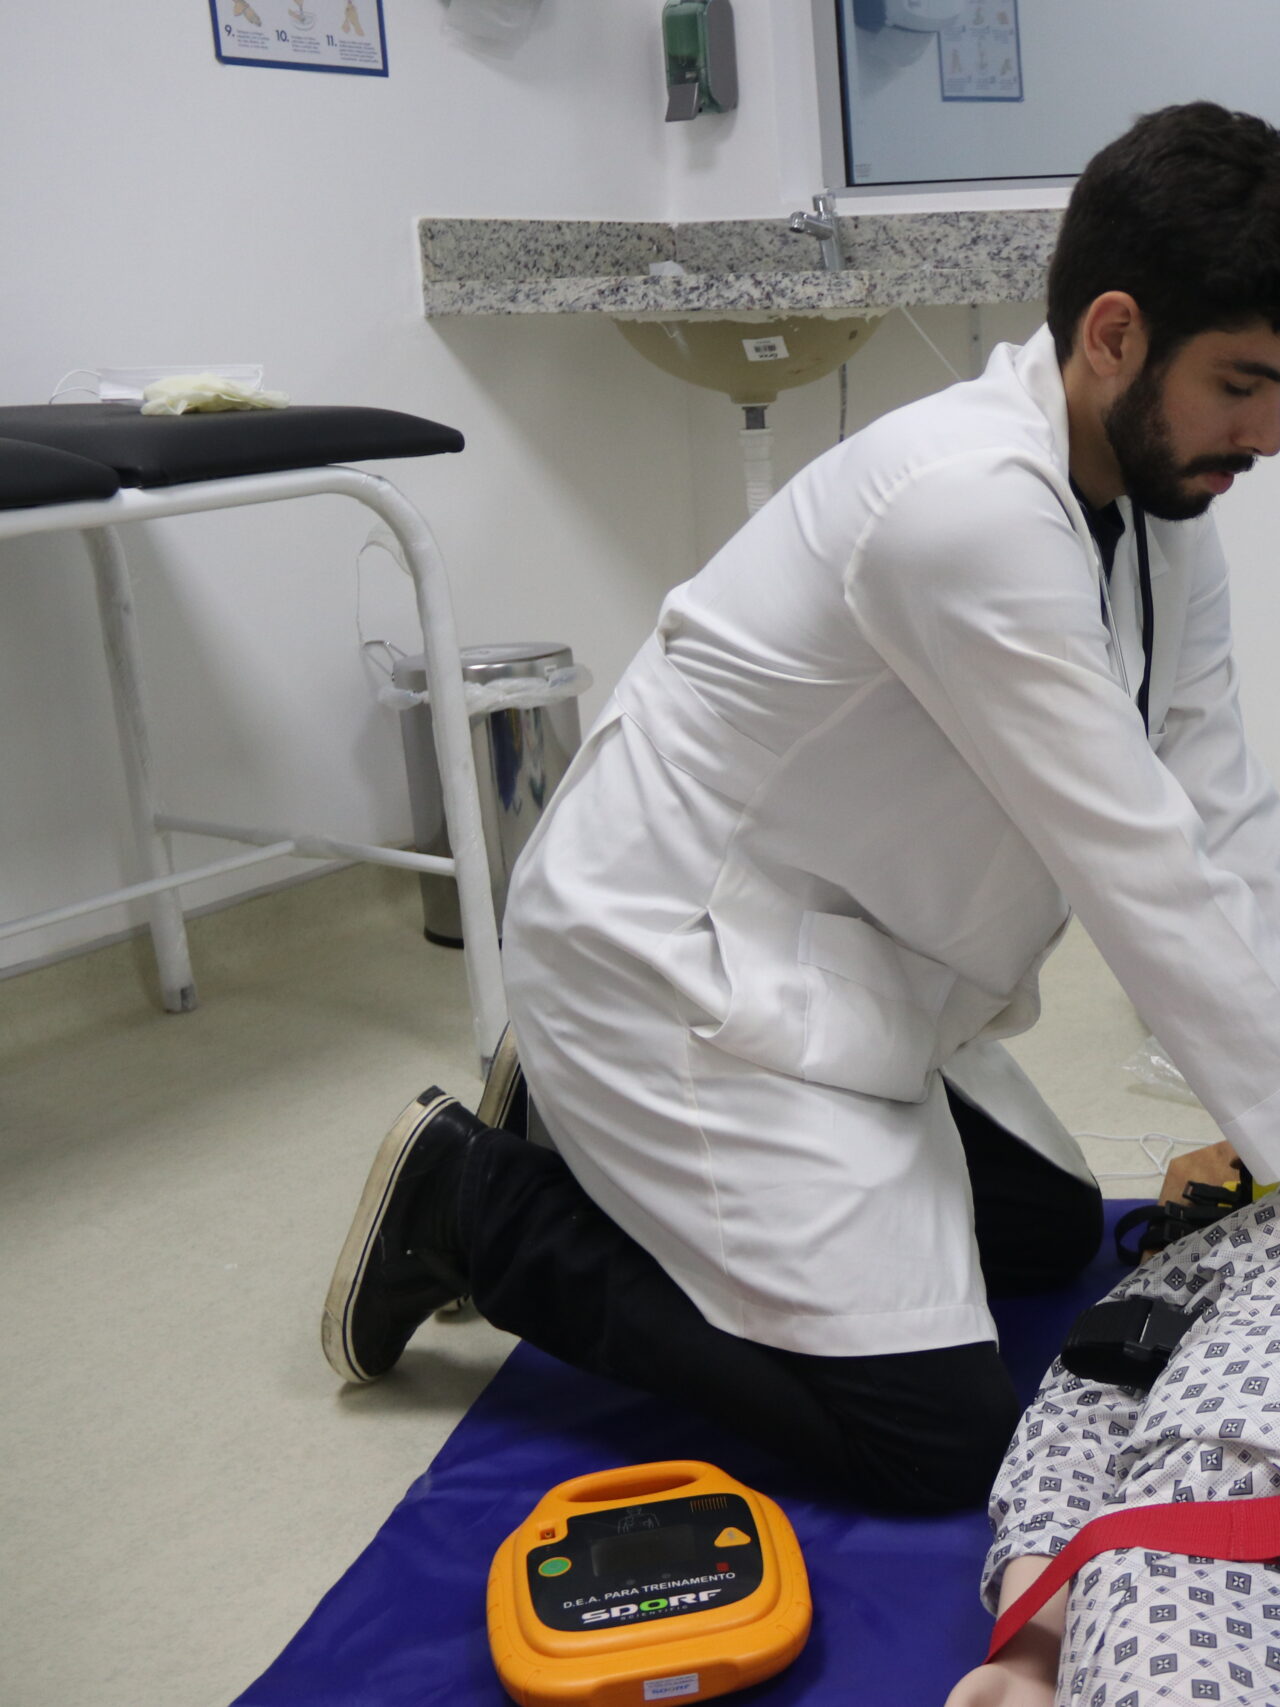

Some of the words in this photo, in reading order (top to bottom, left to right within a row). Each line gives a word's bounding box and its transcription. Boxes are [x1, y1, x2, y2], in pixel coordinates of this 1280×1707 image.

[225, 24, 235, 37] 9.
[276, 29, 290, 43] 10.
[326, 34, 338, 47] 11.
[563, 1595, 601, 1609] D.E.A.
[604, 1587, 640, 1600] PARA
[641, 1572, 736, 1593] TREINAMENTO
[581, 1588, 722, 1624] SDORF
[620, 1604, 688, 1621] SCIENTIFIC
